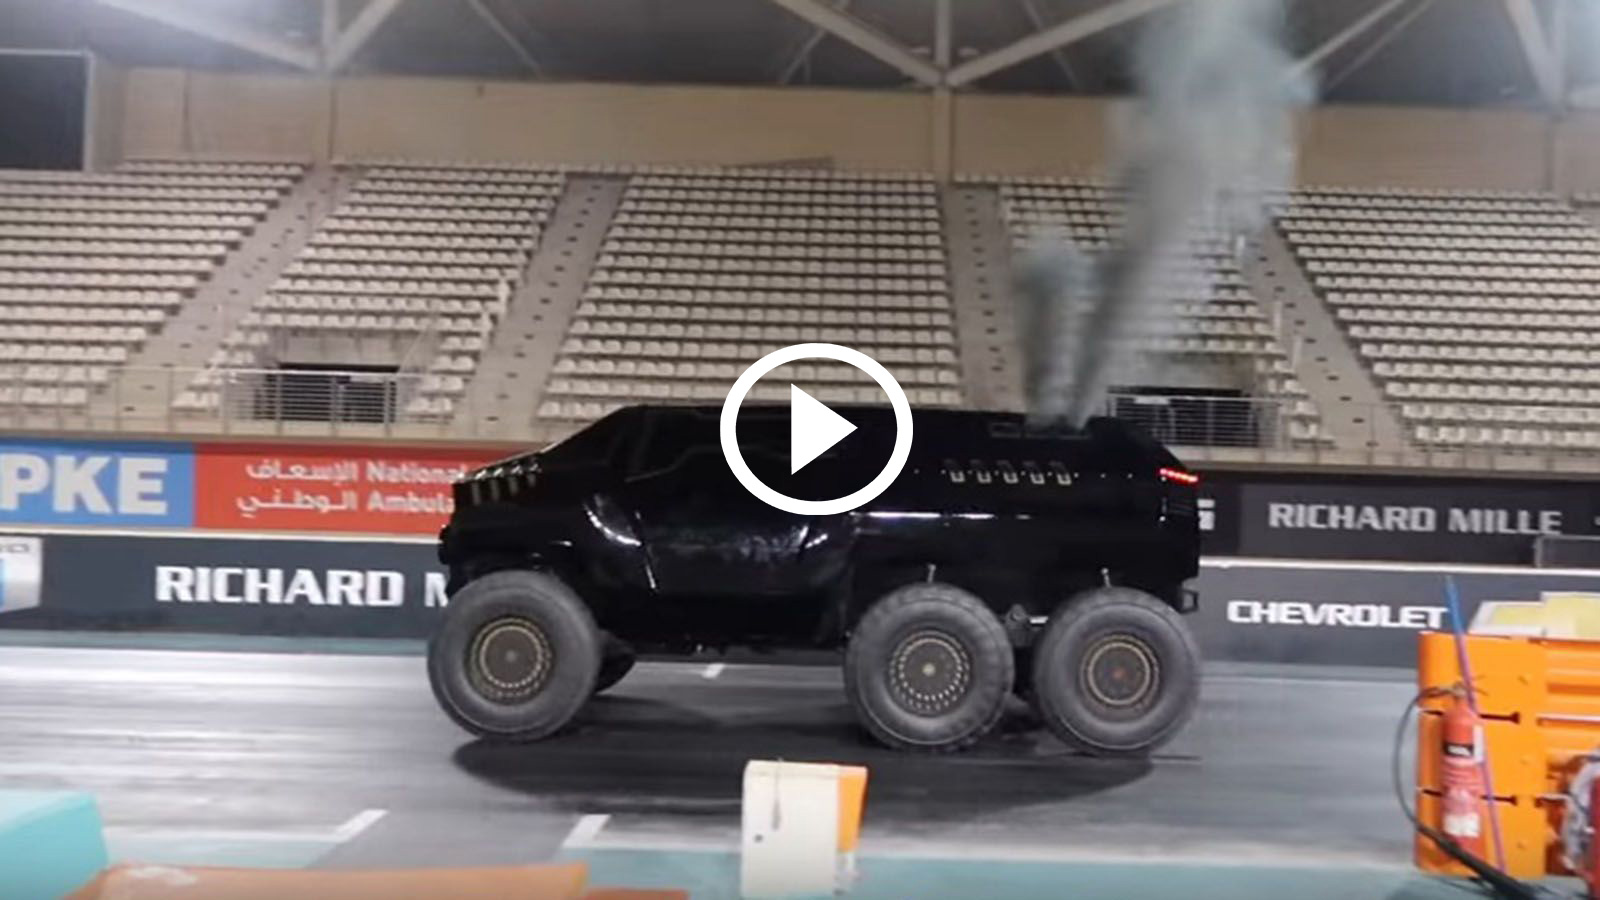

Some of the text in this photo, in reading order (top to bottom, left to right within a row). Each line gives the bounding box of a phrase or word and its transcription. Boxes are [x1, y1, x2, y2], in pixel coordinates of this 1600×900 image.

[367, 490, 455, 514] Ambula
[1268, 502, 1436, 532] RICHARD
[1448, 509, 1563, 536] MILLE
[155, 565, 405, 606] RICHARD
[1227, 600, 1448, 629] CHEVROLET
